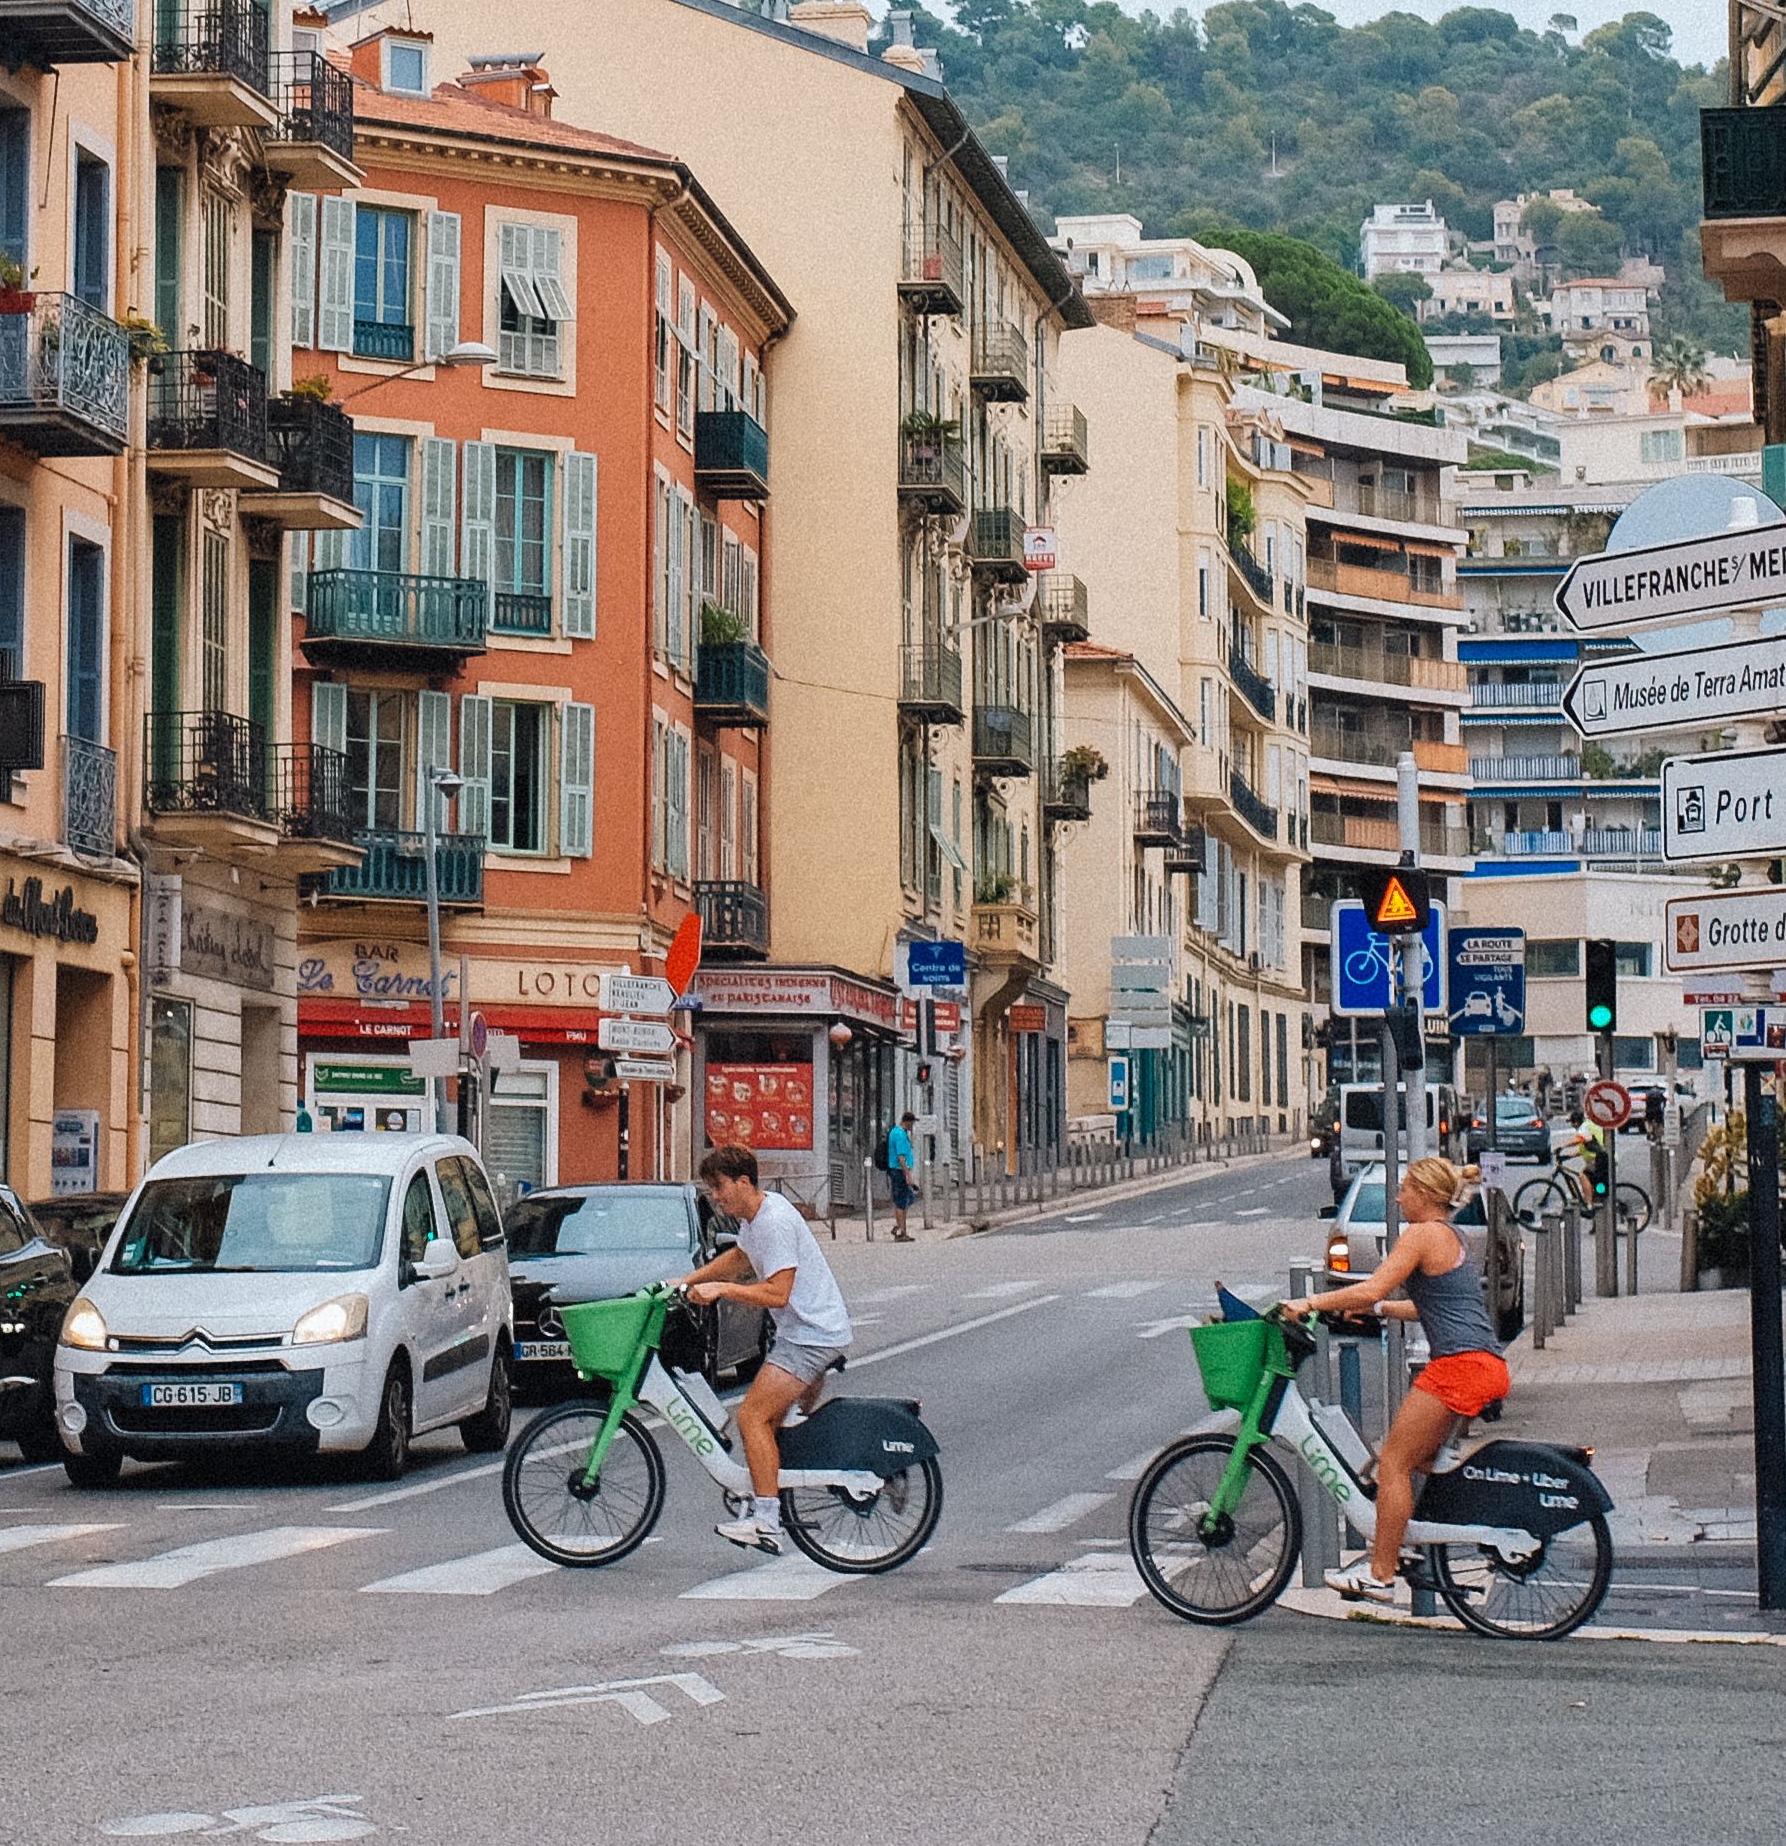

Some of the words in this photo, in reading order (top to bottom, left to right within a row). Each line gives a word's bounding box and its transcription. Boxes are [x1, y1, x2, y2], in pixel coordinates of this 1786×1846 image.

[1614, 676, 1666, 711] Musée
[1670, 675, 1690, 703] de
[1694, 670, 1735, 700] Terra
[1715, 788, 1773, 824] Port
[1708, 915, 1769, 946] Grotte
[354, 943, 399, 963] BAR
[911, 962, 946, 973] Centre
[948, 962, 961, 973] de
[518, 970, 600, 998] LOTO
[360, 1024, 372, 1034] LE
[373, 1025, 413, 1036] CARNOT
[665, 1397, 714, 1456] Lime
[882, 1439, 915, 1454] Lime
[1300, 1433, 1352, 1502] Lime
[1462, 1466, 1485, 1481] On
[1485, 1465, 1520, 1484] Lime
[1532, 1472, 1570, 1491] Uber
[1538, 1493, 1579, 1510] Lime
